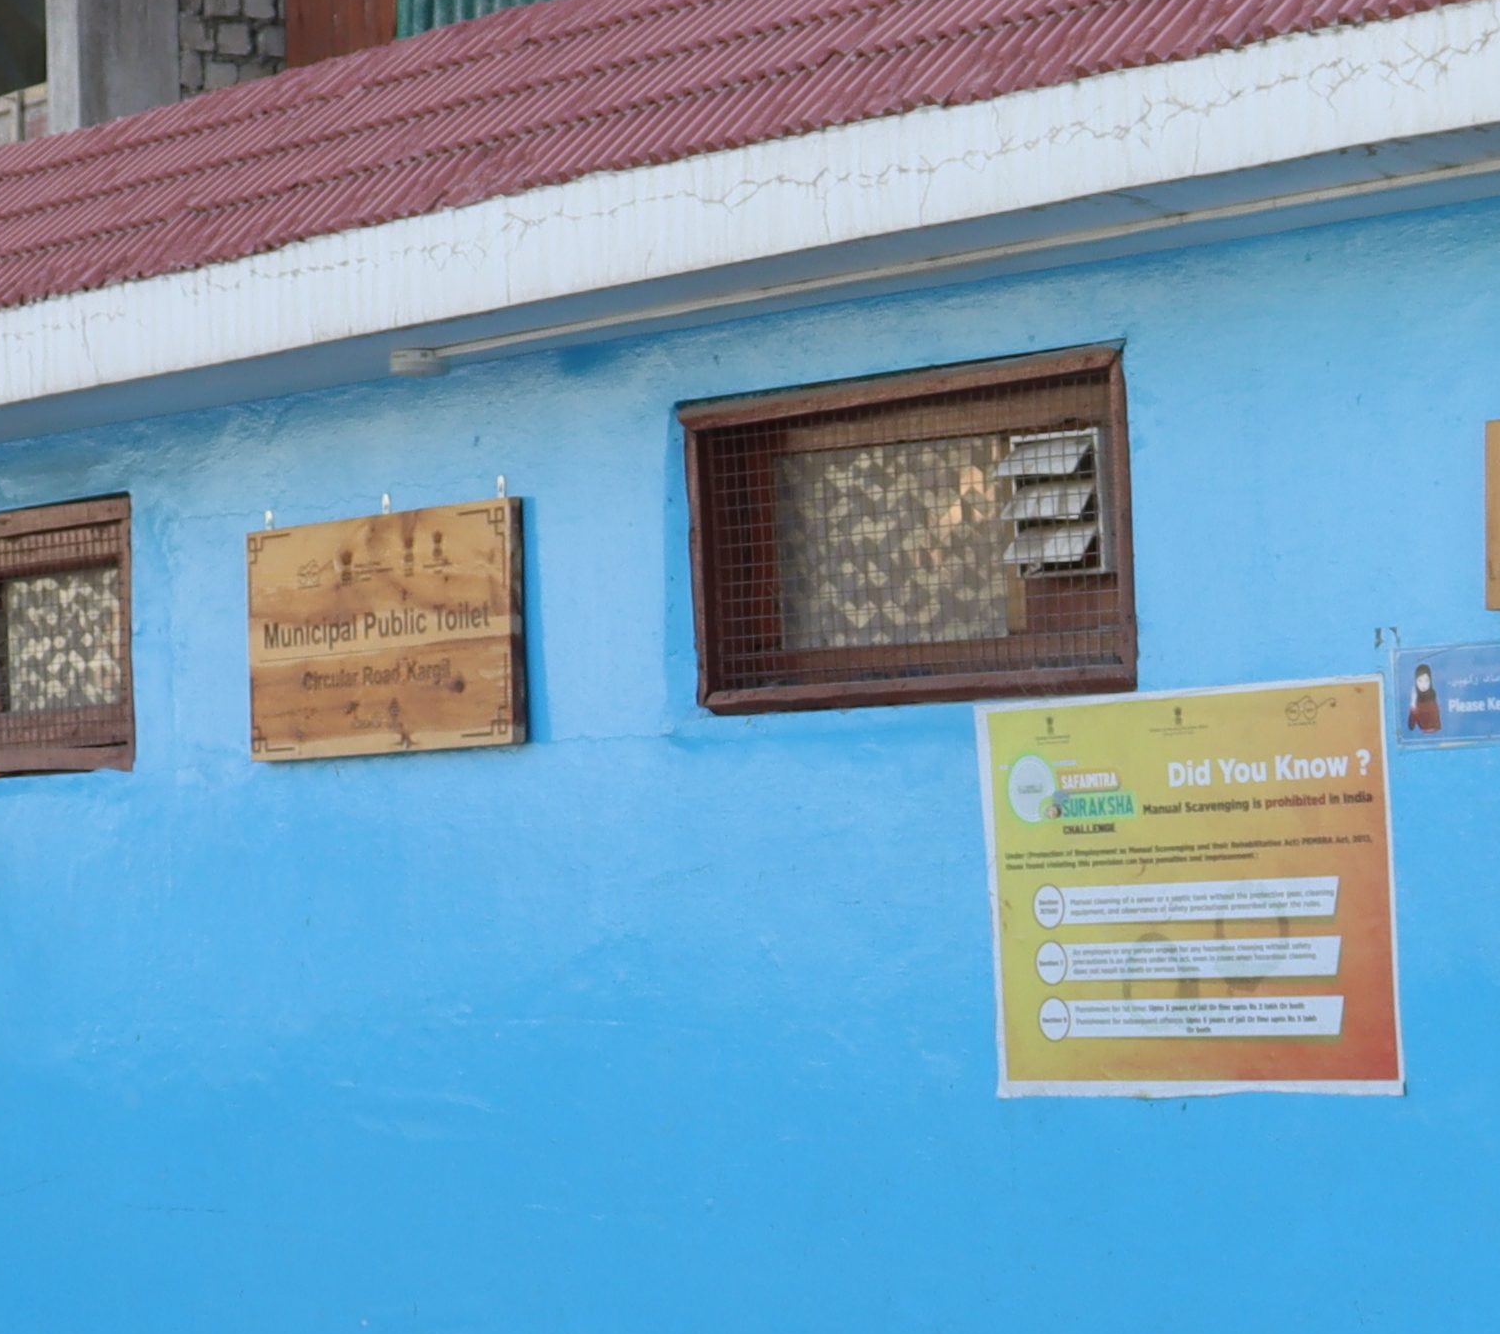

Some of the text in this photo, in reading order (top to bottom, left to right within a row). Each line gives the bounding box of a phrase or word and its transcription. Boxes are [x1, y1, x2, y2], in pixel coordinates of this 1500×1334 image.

[263, 602, 490, 650] Municipal Public Toilet
[302, 668, 357, 690] Circular
[363, 663, 399, 685] Road
[1448, 698, 1485, 712] Please
[1168, 749, 1371, 787] Did You Know ?
[1062, 795, 1134, 817] SURAKSHA
[1143, 792, 1372, 814] Manual Scavenging is prohibited in India
[1063, 823, 1115, 834] CHALLENGE
